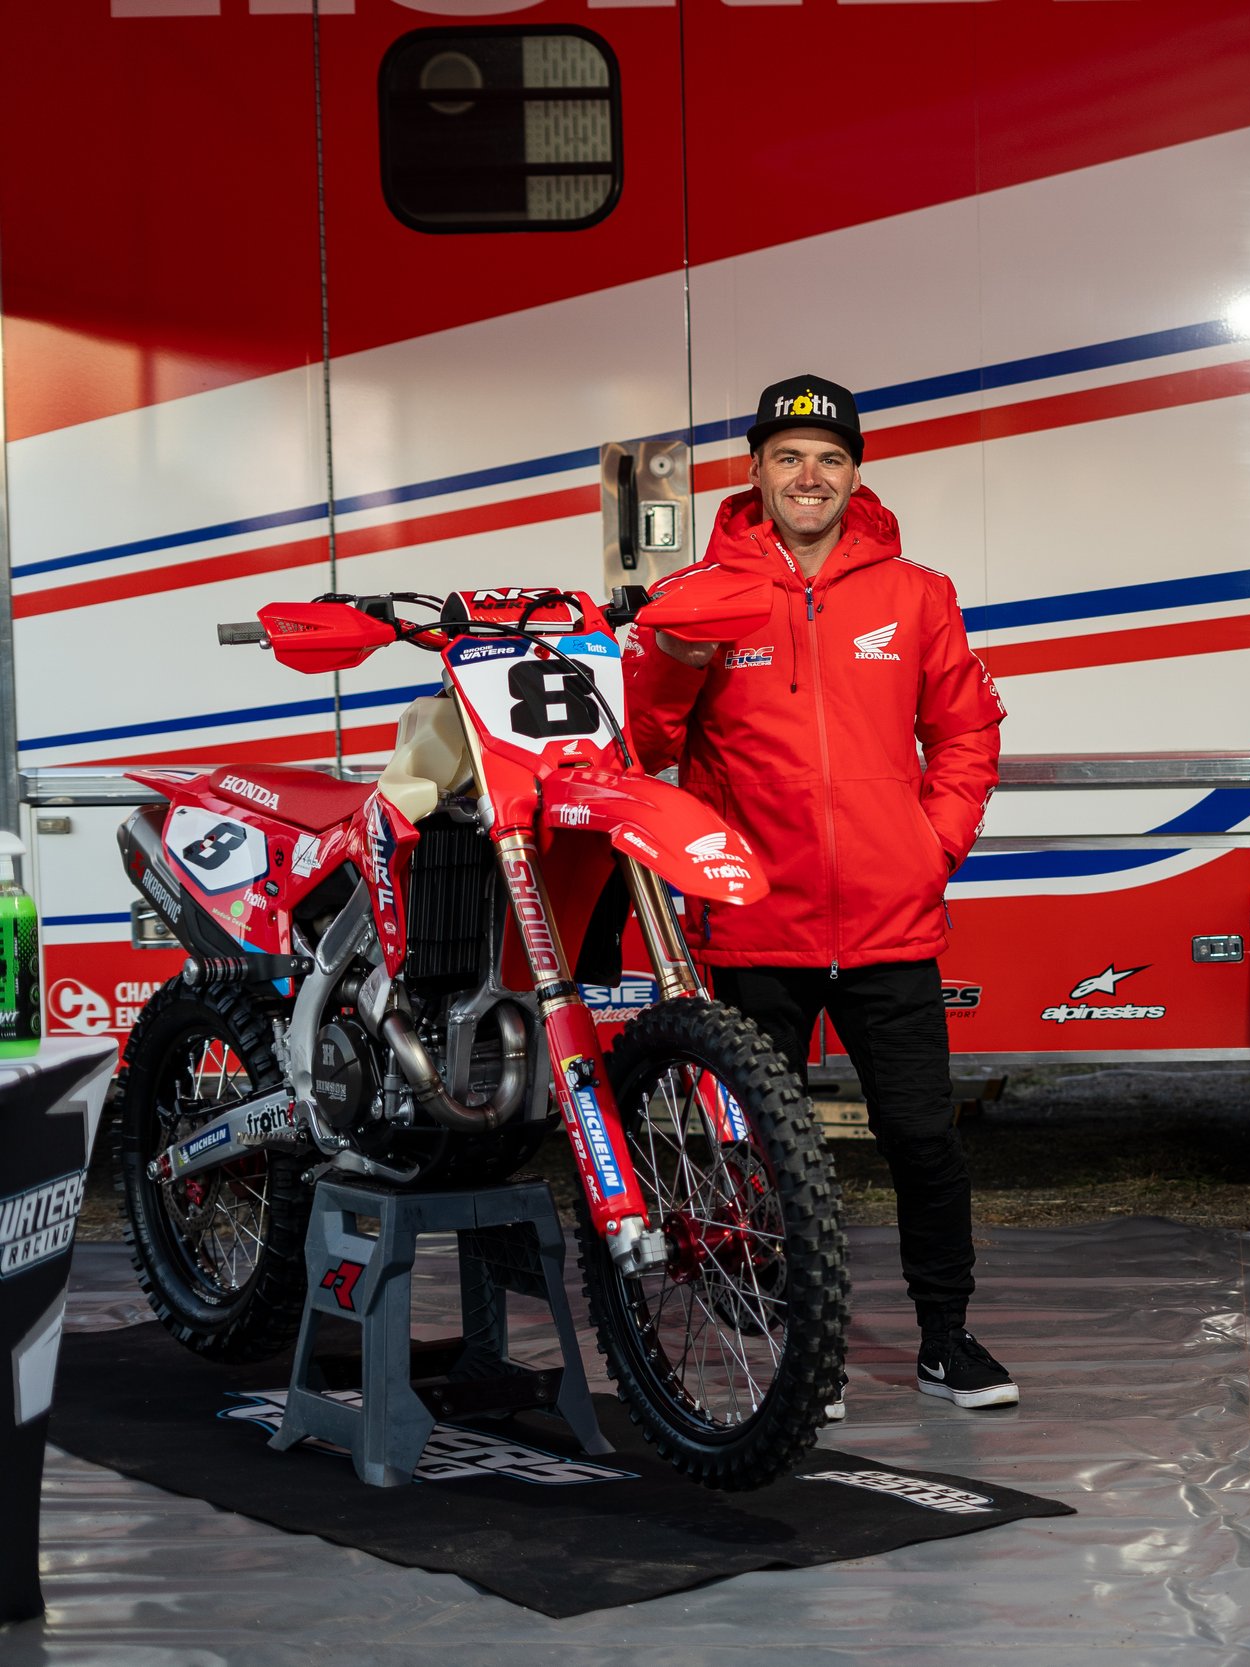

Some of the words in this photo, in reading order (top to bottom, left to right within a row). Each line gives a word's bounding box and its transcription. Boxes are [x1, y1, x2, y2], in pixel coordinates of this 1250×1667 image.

[775, 395, 837, 418] froth
[775, 541, 796, 573] HONDA
[460, 647, 515, 661] WATERS
[463, 645, 493, 654] BRODIE
[586, 643, 607, 653] Tatts
[725, 646, 774, 666] HRC
[855, 652, 900, 661] HONDA
[508, 659, 600, 738] 8
[219, 775, 280, 810] HONDA
[560, 804, 590, 825] froth
[182, 822, 247, 870] 8
[691, 852, 744, 864] HONDA
[703, 863, 751, 879] froth
[142, 869, 182, 925] AKRAPOVIČ
[244, 889, 267, 910] froth
[502, 859, 561, 974] SHOWA
[1041, 1004, 1166, 1023] alpinestars
[316, 1080, 347, 1094] HINSON
[246, 1104, 287, 1135] froth
[188, 1127, 227, 1155] MICHELIN
[571, 1130, 587, 1164] 727
[577, 1091, 620, 1187] MICHELIN
[8, 1223, 70, 1266] RACING
